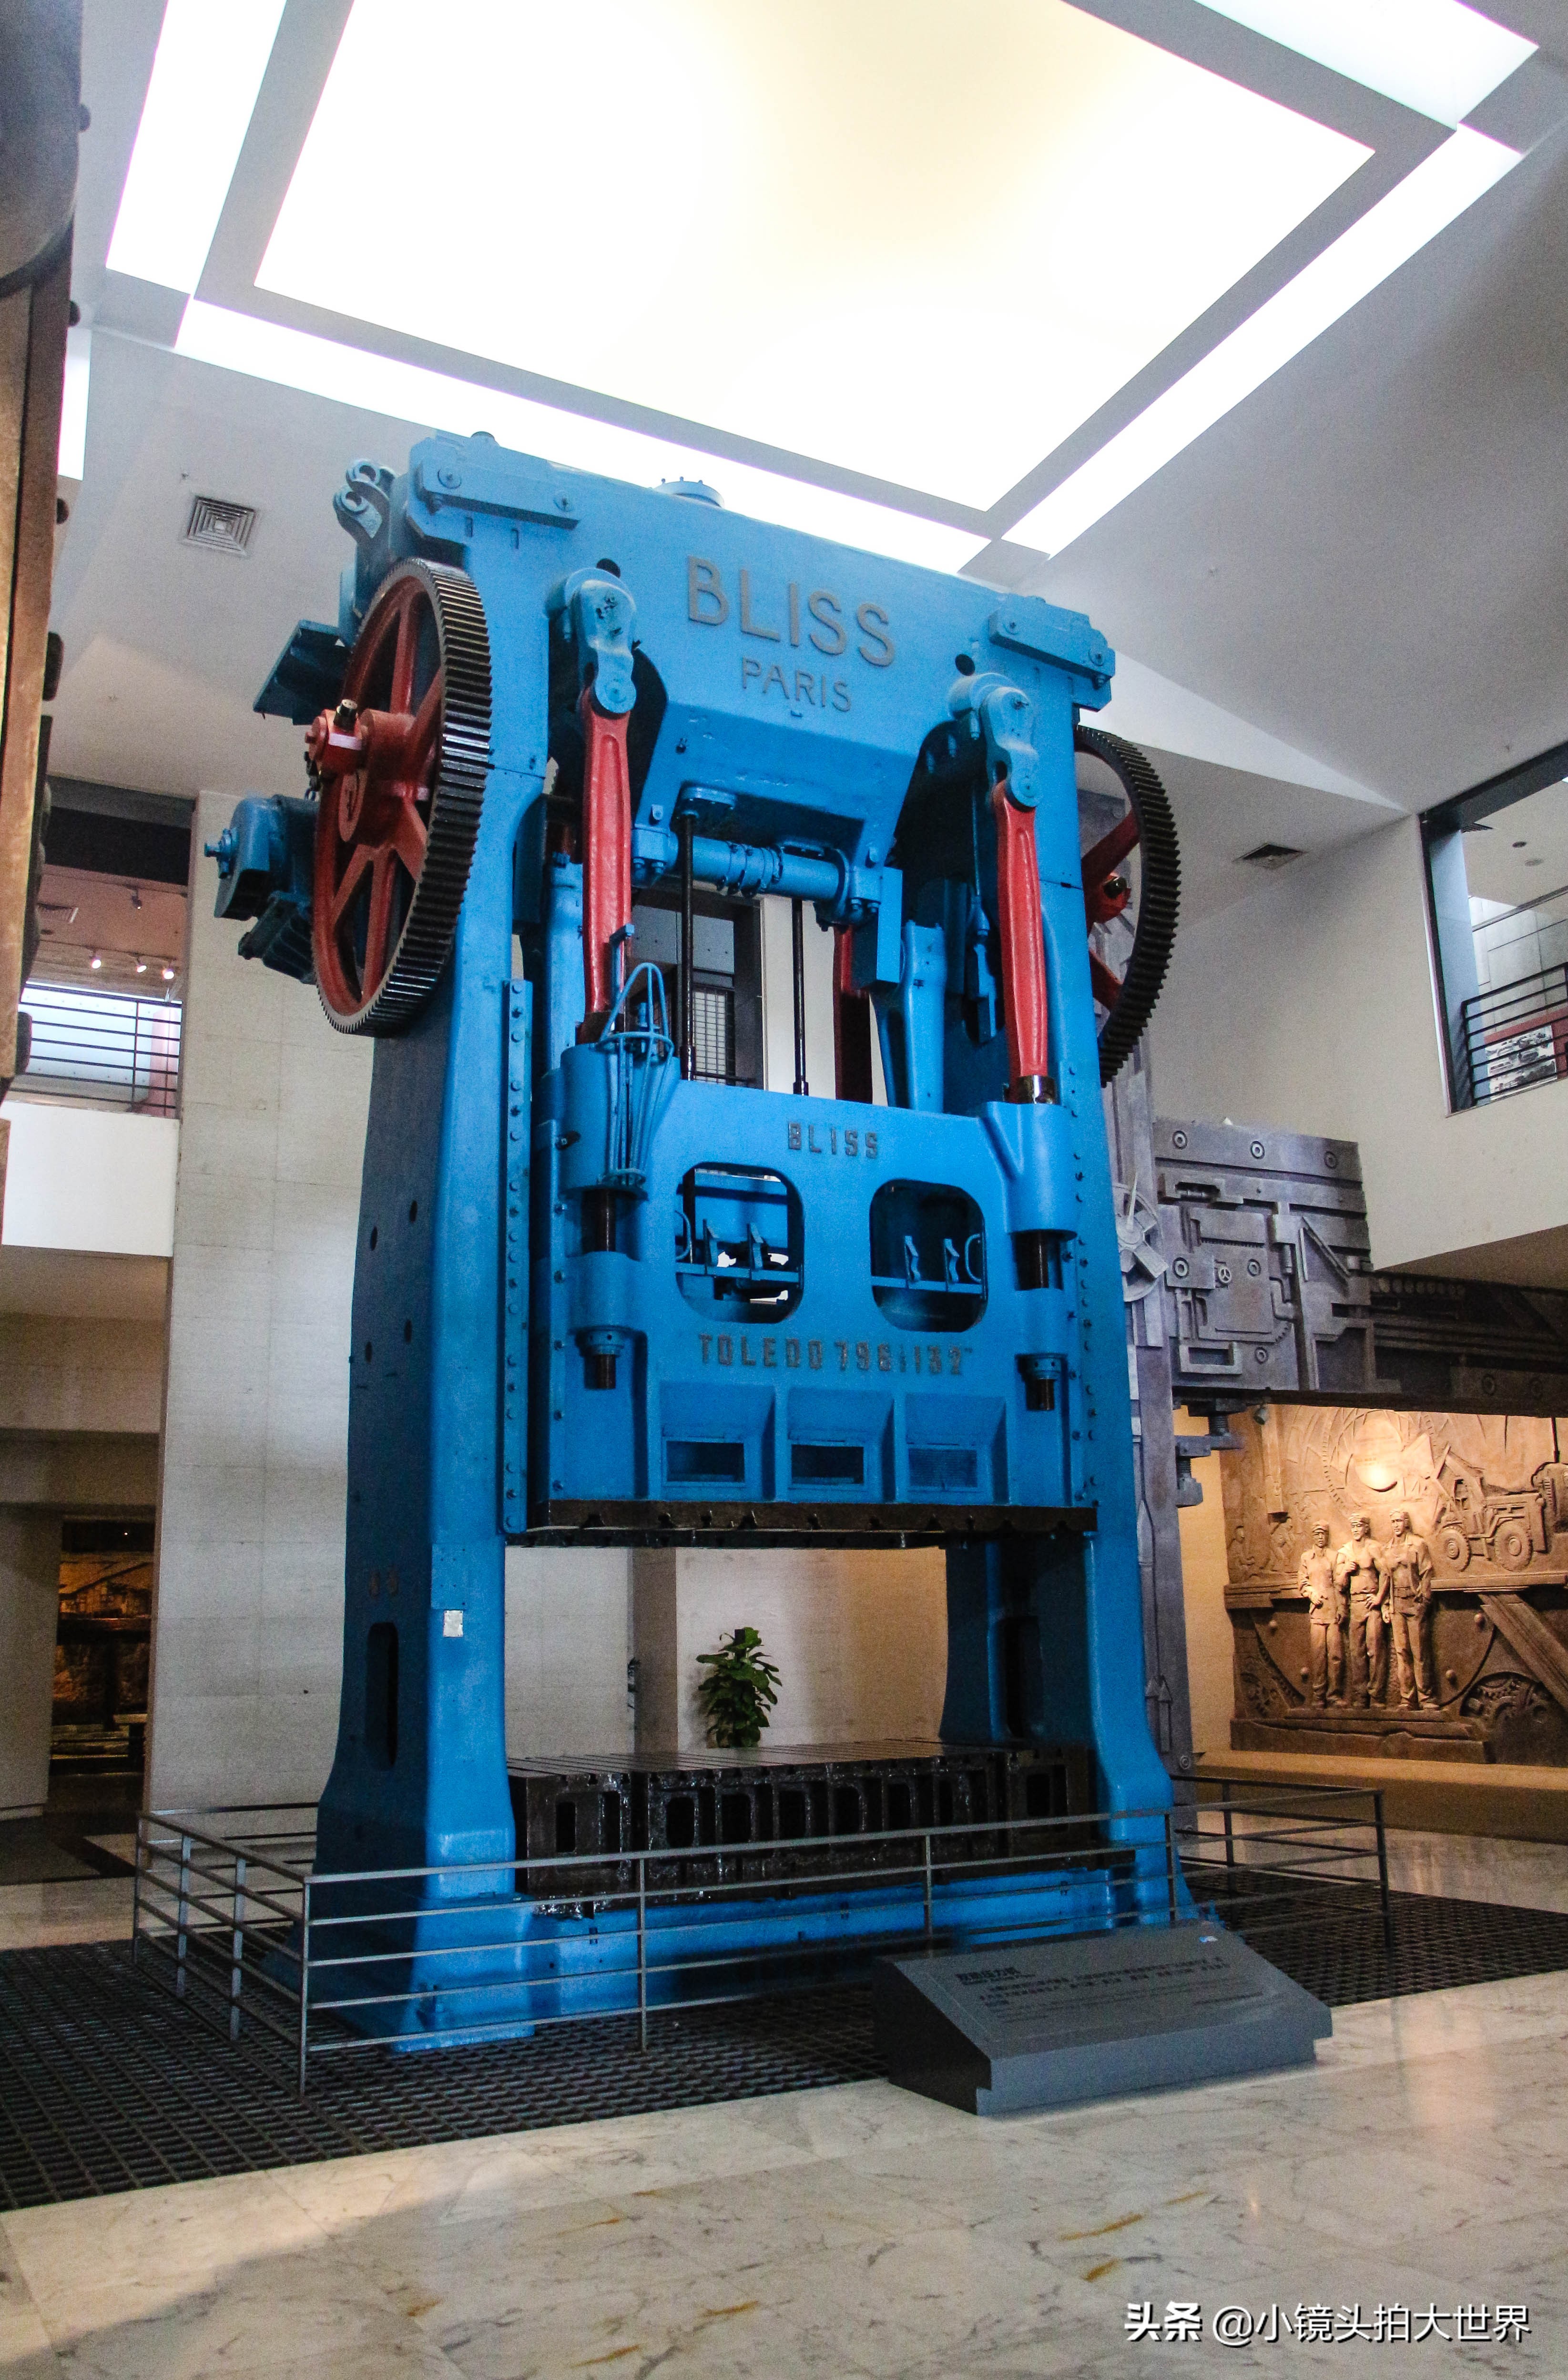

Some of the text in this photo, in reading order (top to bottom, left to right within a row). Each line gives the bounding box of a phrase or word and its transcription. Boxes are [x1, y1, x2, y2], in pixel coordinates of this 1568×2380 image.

[688, 555, 895, 667] BLISS
[743, 656, 851, 712] PARIS
[788, 1122, 877, 1159] BLISS
[698, 1333, 823, 1369] TOLEDO
